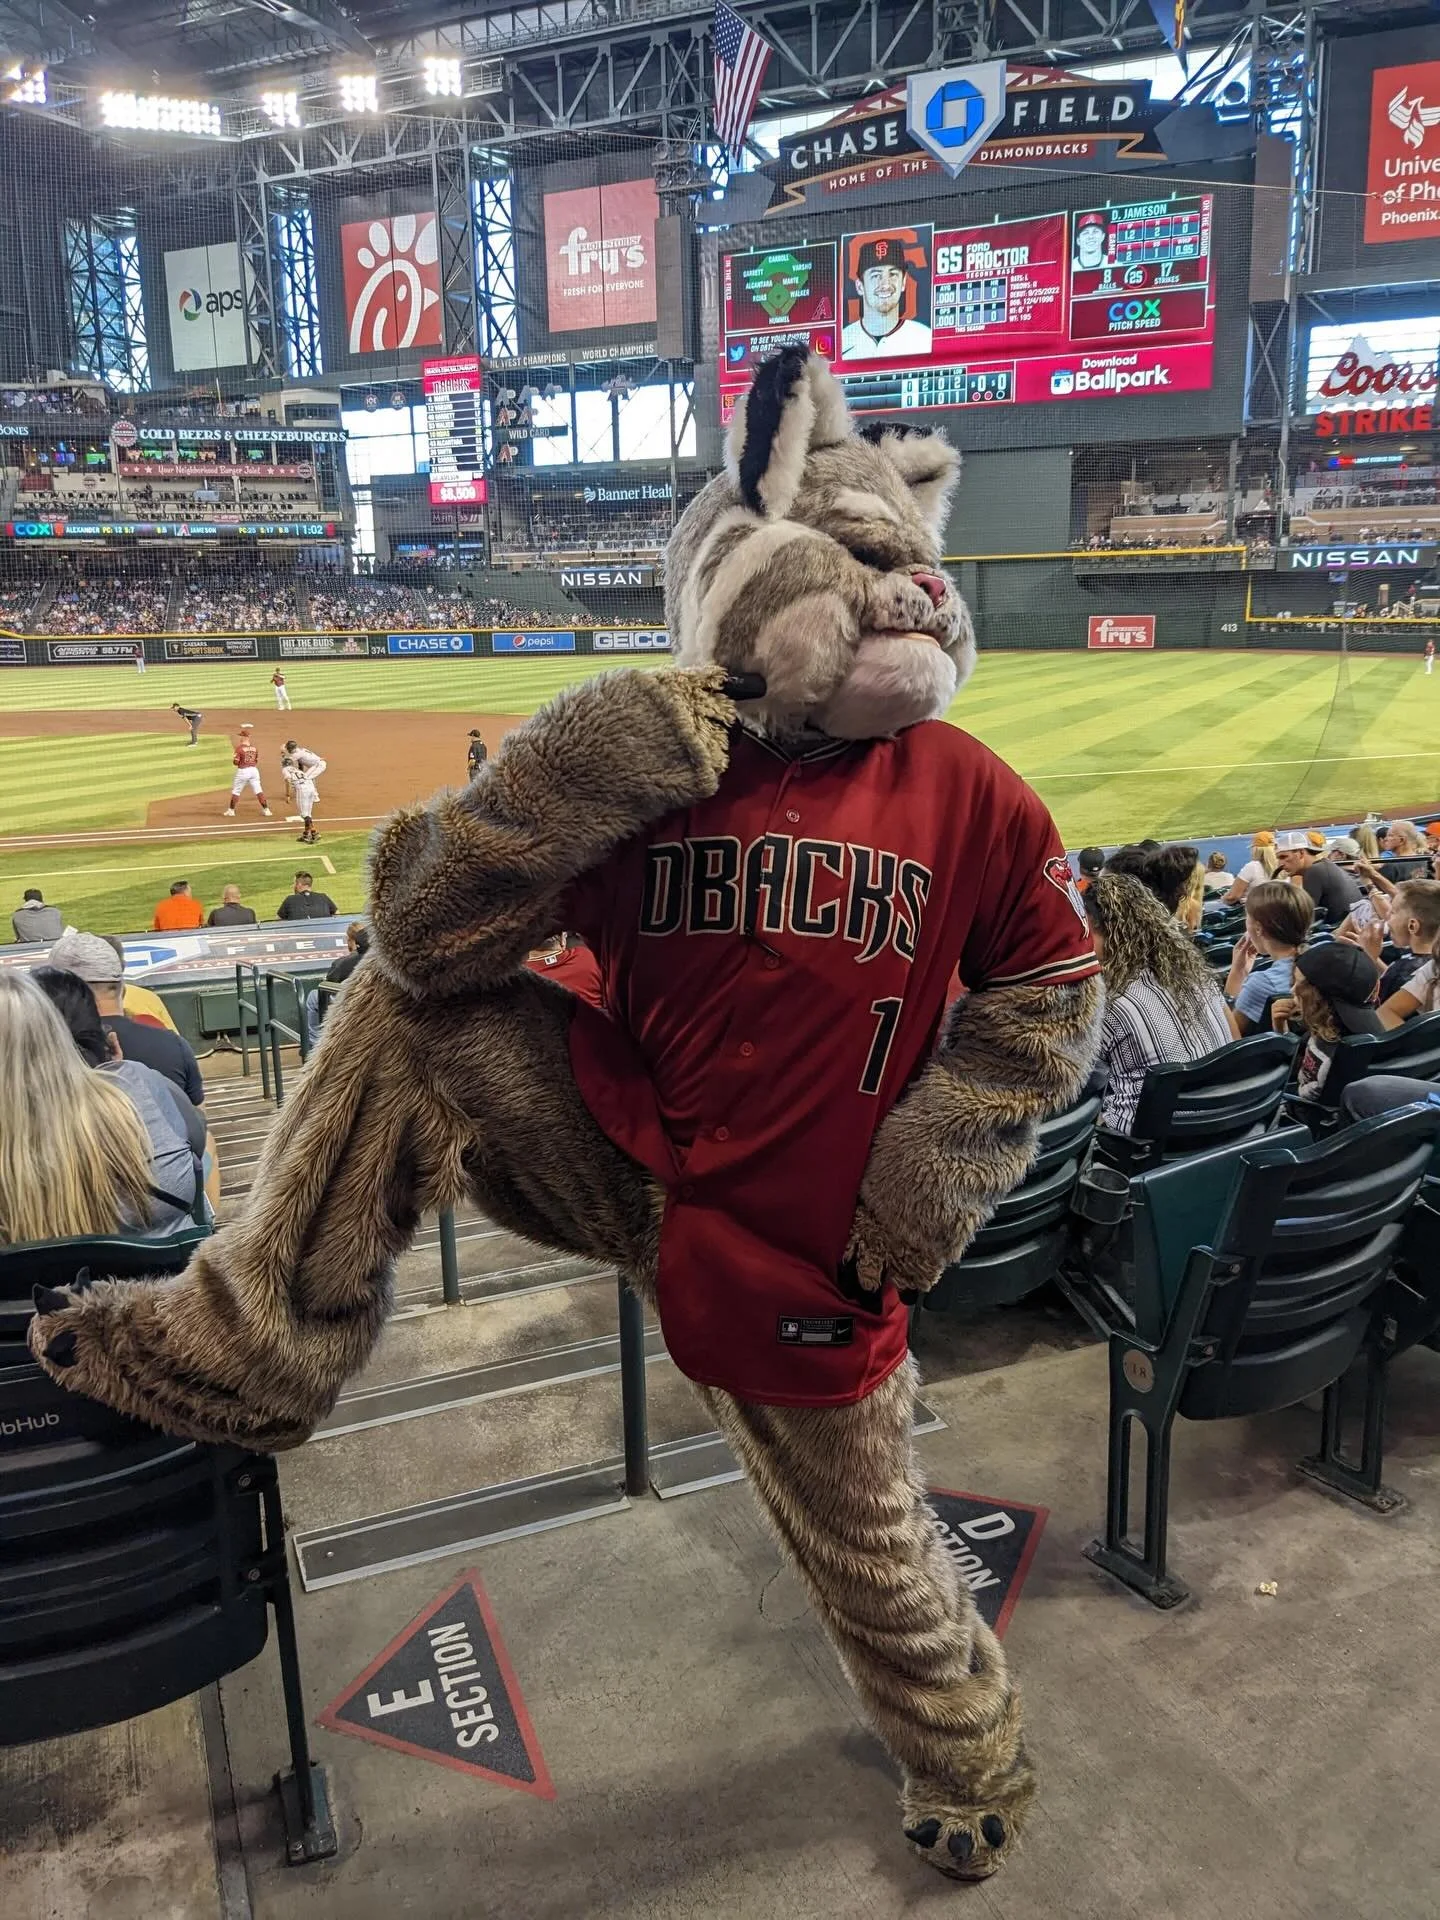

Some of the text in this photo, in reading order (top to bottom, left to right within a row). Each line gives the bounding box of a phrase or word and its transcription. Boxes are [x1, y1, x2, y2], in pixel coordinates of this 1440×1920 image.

[790, 96, 1135, 171] CHASE FIELD
[980, 143, 1089, 161] DIAMONDBACKS
[829, 160, 929, 191] HOME OF THE
[1383, 182, 1407, 204] of
[1112, 204, 1167, 220] D. JAMESON
[1202, 213, 1210, 228] THE
[1154, 227, 1160, 237] 2
[1182, 223, 1189, 234] 0
[966, 242, 990, 253] FORD
[1201, 229, 1209, 256] MOUND
[559, 227, 645, 276] fry's
[937, 246, 963, 274] 65
[966, 247, 1029, 271] PROCTOR
[1126, 251, 1132, 261] 2
[966, 268, 1015, 279] SECOND BASE
[1103, 262, 1173, 284] 8 25 17
[563, 280, 645, 297] FRESH FOR EVERYONE
[790, 289, 810, 298] WALKER
[967, 290, 973, 301] 0
[991, 288, 998, 298] 0
[206, 289, 243, 318] aps
[1108, 299, 1161, 321] COX
[966, 313, 972, 324] 0
[991, 311, 997, 321] 0
[1109, 318, 1161, 331] PITCH SPEED
[750, 337, 758, 345] TO
[759, 335, 770, 343] SEE
[771, 334, 786, 342] YOUR
[523, 353, 567, 366] CHAMPIONS
[582, 344, 655, 360] WORLD CHAMPIONS
[1082, 353, 1138, 369] Download
[978, 374, 1007, 391] 0 0
[1075, 364, 1169, 393] Ballpark
[1318, 352, 1439, 397] Coors
[922, 376, 961, 391] 2 0 2
[938, 392, 944, 404] 0
[1316, 404, 1433, 437] STRIKE
[140, 429, 175, 440] COLD
[179, 429, 221, 440] BEERS
[224, 430, 232, 440] &
[234, 430, 347, 442] CHEESEBURGERS
[509, 427, 550, 439] WILD CARD
[598, 483, 673, 501] Banner Healt
[15, 523, 51, 536] COX
[302, 525, 323, 535] 1:02
[1292, 549, 1419, 569] NISSAN
[561, 572, 642, 586] NISSAN
[1095, 619, 1147, 645] fry's
[1220, 623, 1238, 633] 413
[282, 637, 335, 648] HIT THE BUDS
[399, 638, 448, 649] CHASE
[527, 637, 554, 648] pepsi
[595, 632, 671, 649] GEICO
[183, 646, 225, 654] SPORTSBOOK
[371, 646, 386, 655] 374
[639, 832, 933, 965] DBACKS
[858, 997, 903, 1095] 1
[0, 1412, 60, 1435] bHub
[958, 1511, 1016, 1540] D
[923, 1507, 1002, 1592] CTION
[427, 1621, 500, 1748] SECTION
[366, 1679, 435, 1718] E
